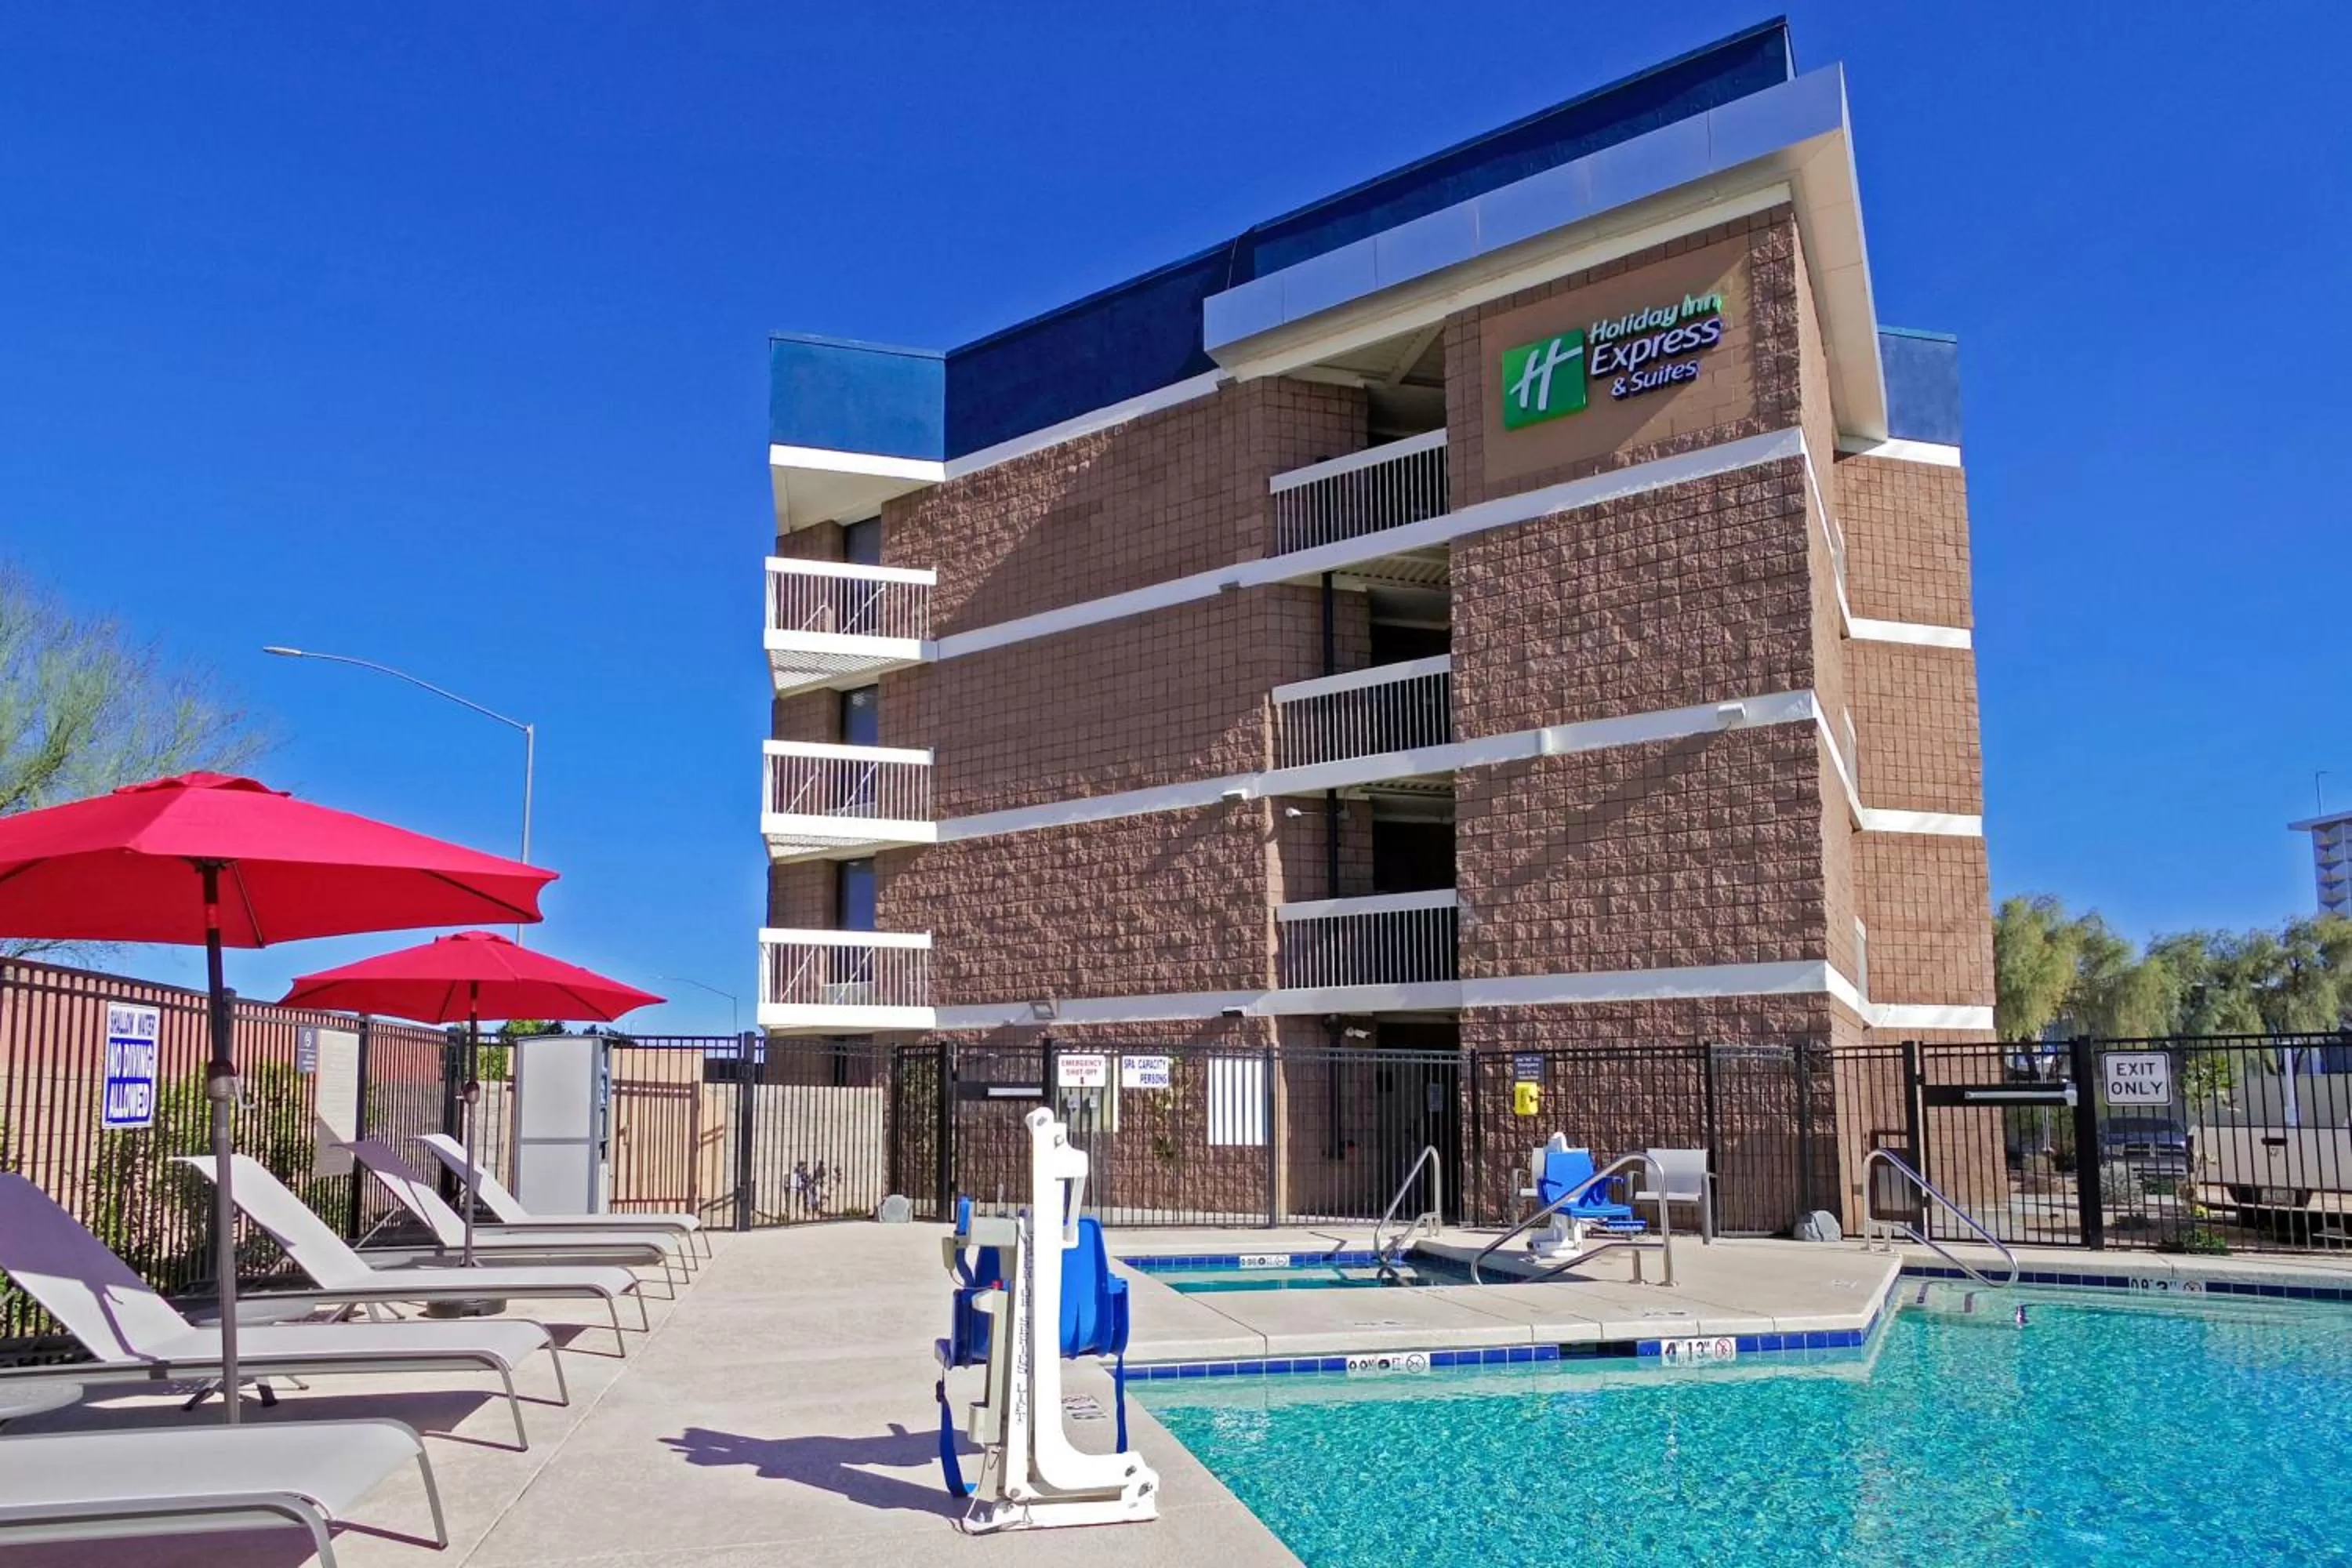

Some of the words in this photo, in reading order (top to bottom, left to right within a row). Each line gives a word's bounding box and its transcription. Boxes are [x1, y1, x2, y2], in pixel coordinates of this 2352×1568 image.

[1588, 306, 1679, 344] Holiday
[1681, 292, 1722, 317] Inn
[1590, 317, 1722, 376] Express
[1611, 376, 1627, 397] &
[1631, 360, 1700, 391] Suites
[111, 1010, 134, 1034] SHALLOW
[109, 1042, 122, 1078] NO
[123, 1043, 154, 1078] DIVING
[1123, 1058, 1136, 1069] SPA
[1138, 1058, 1167, 1069] CAPACITY
[2116, 1062, 2156, 1076] EXIT
[1139, 1073, 1167, 1084] PERSONS
[2111, 1081, 2164, 1095] ONLY
[108, 1083, 150, 1118] ALLOWED
